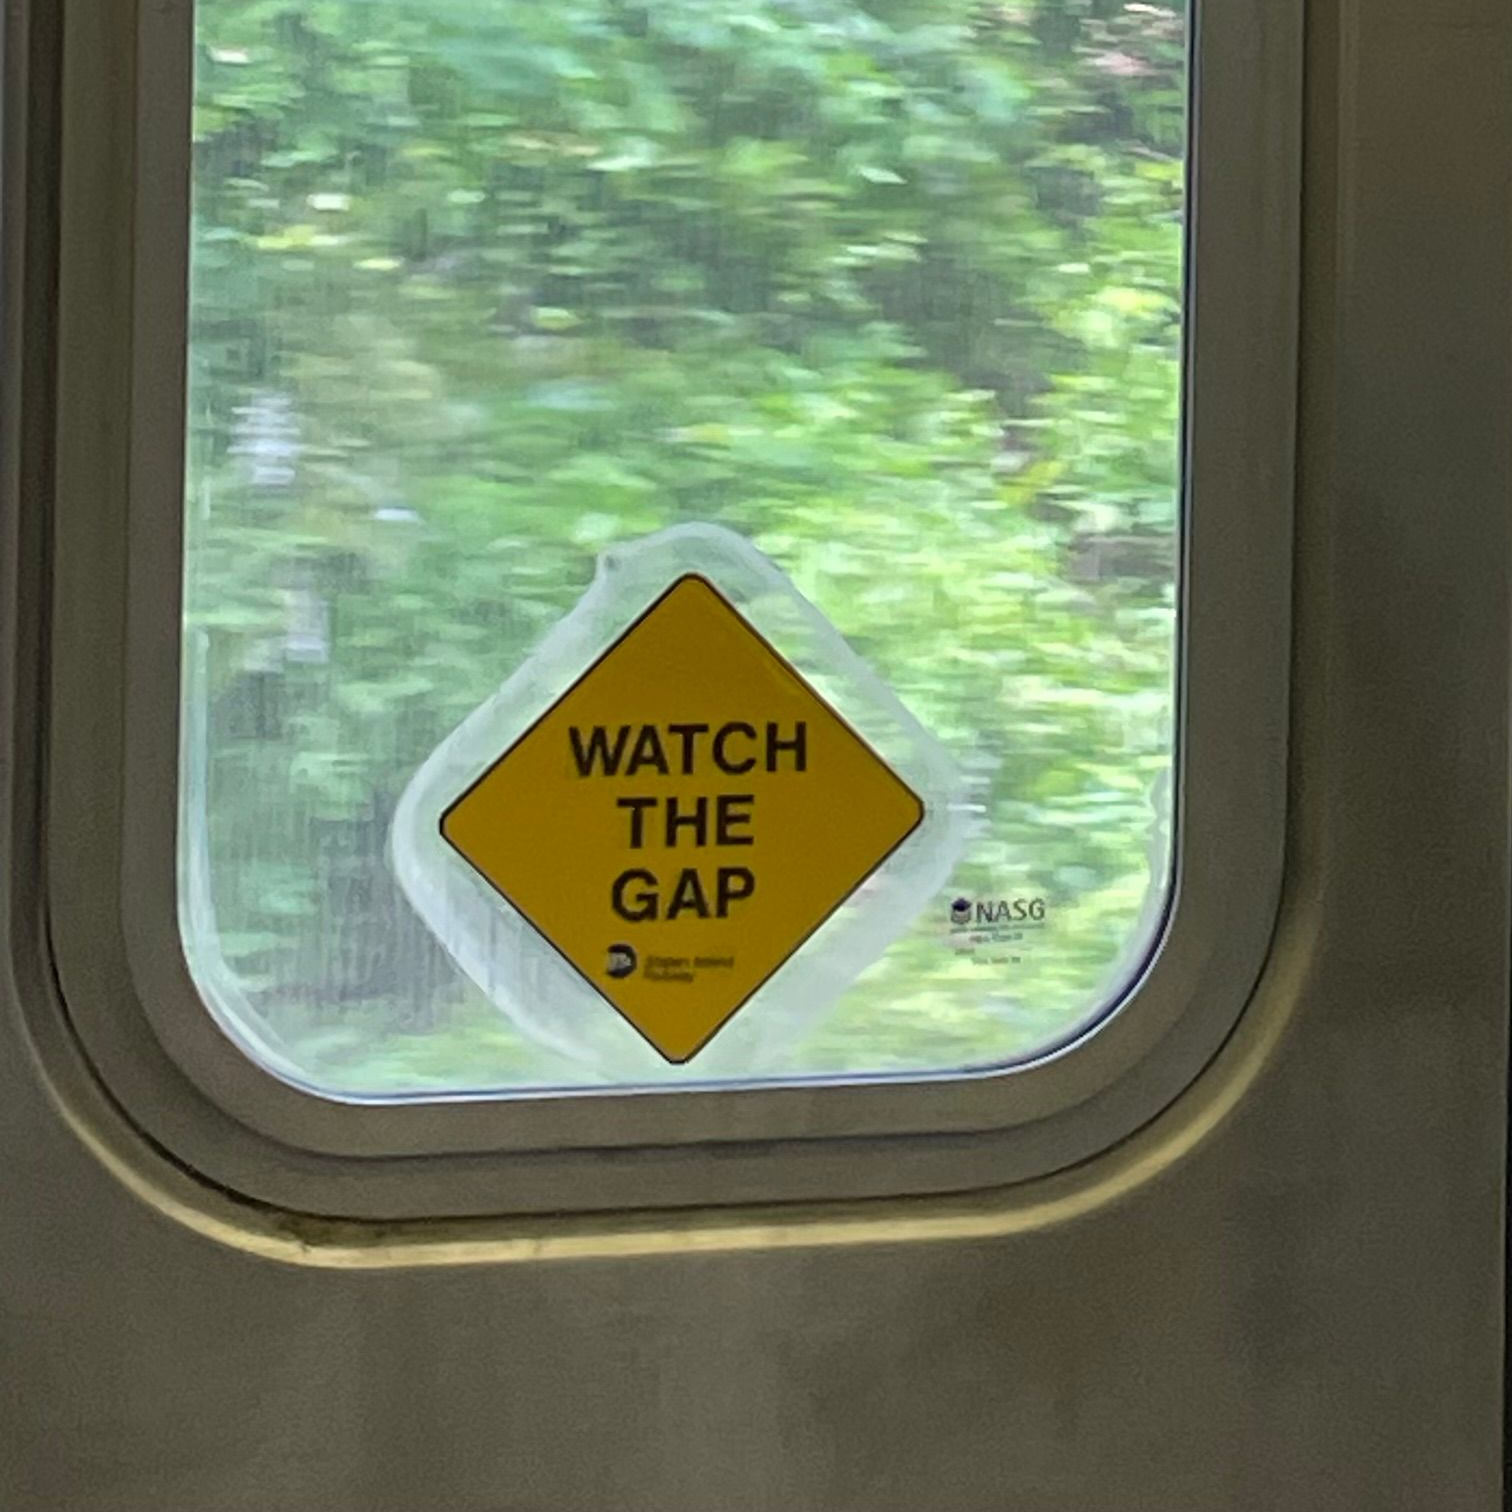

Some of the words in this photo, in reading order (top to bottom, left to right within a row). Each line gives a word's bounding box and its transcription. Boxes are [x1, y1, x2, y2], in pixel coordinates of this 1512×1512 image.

[567, 720, 808, 779] WATCH
[615, 793, 756, 850] THE
[610, 865, 756, 924] GAP
[975, 897, 1046, 923] NASG
